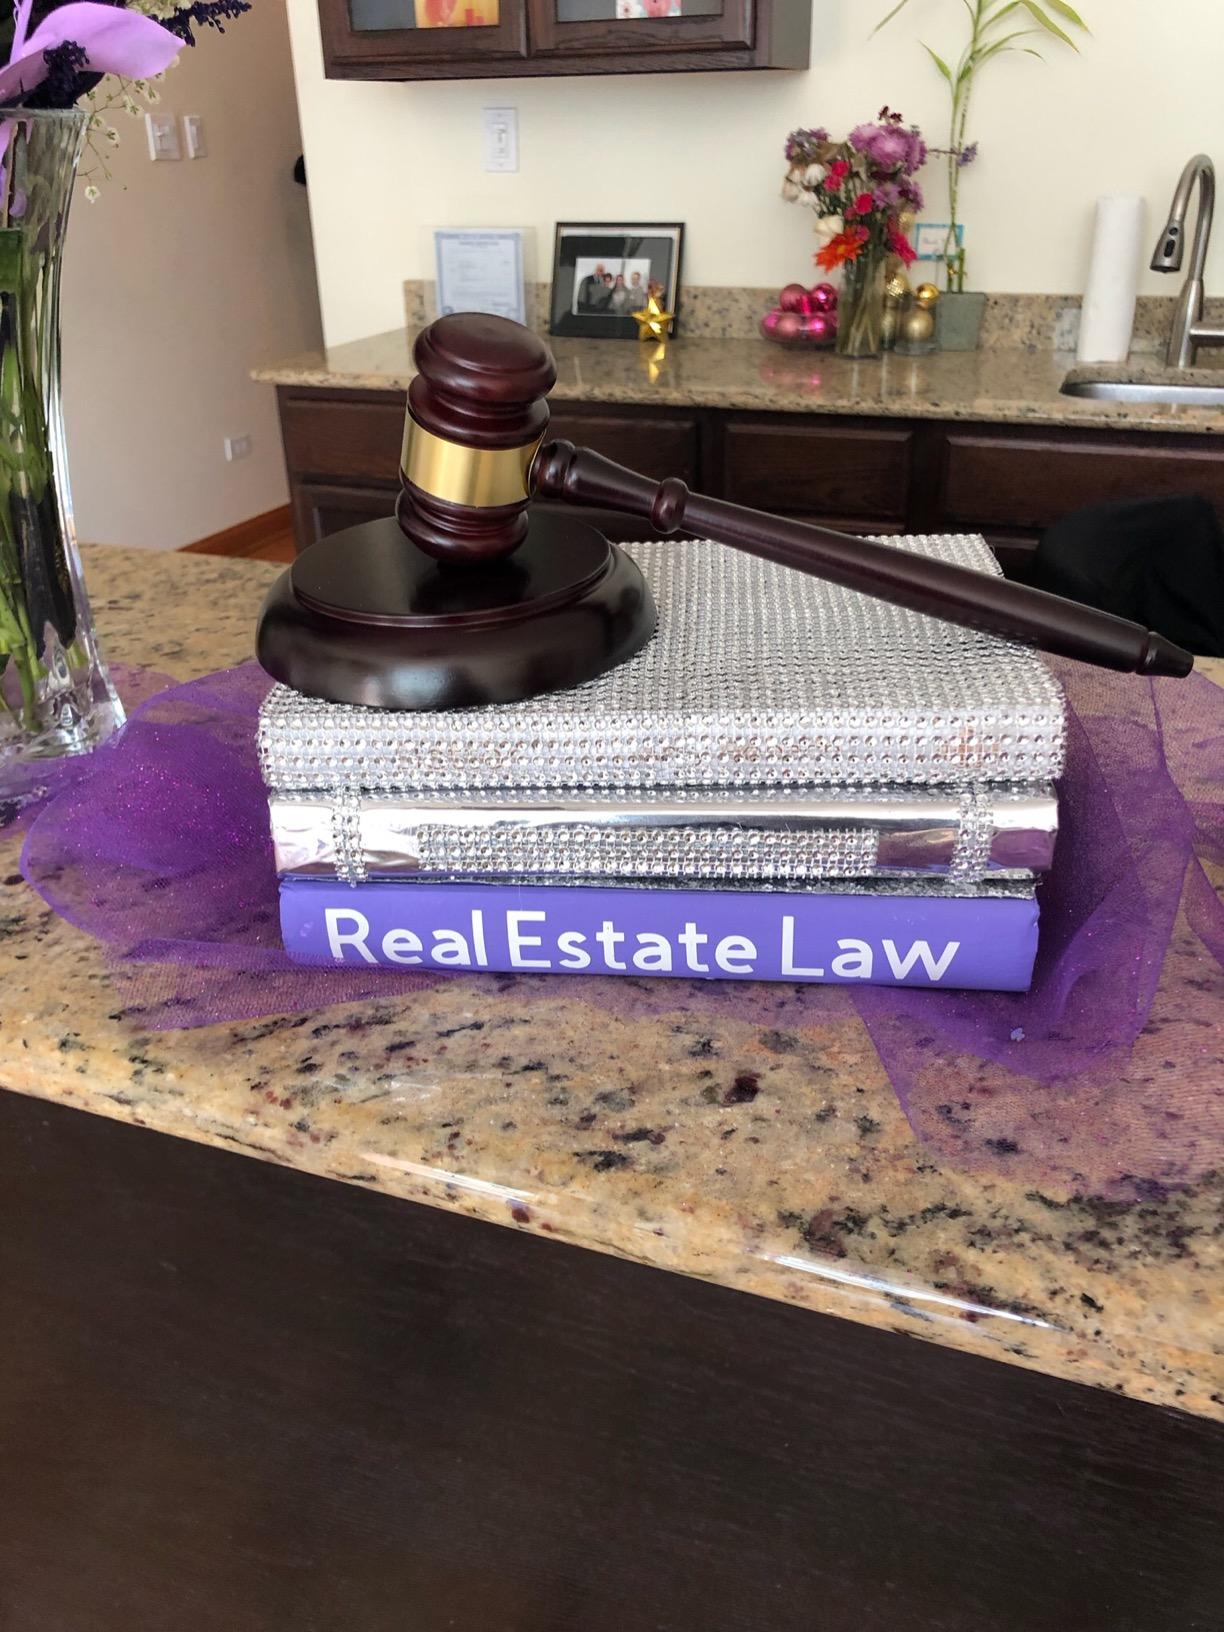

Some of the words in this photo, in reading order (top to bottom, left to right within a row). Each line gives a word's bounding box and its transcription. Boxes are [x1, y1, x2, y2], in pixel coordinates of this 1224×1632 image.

[324, 907, 488, 968] Real
[506, 909, 758, 974] Estate
[781, 915, 961, 981] Law
